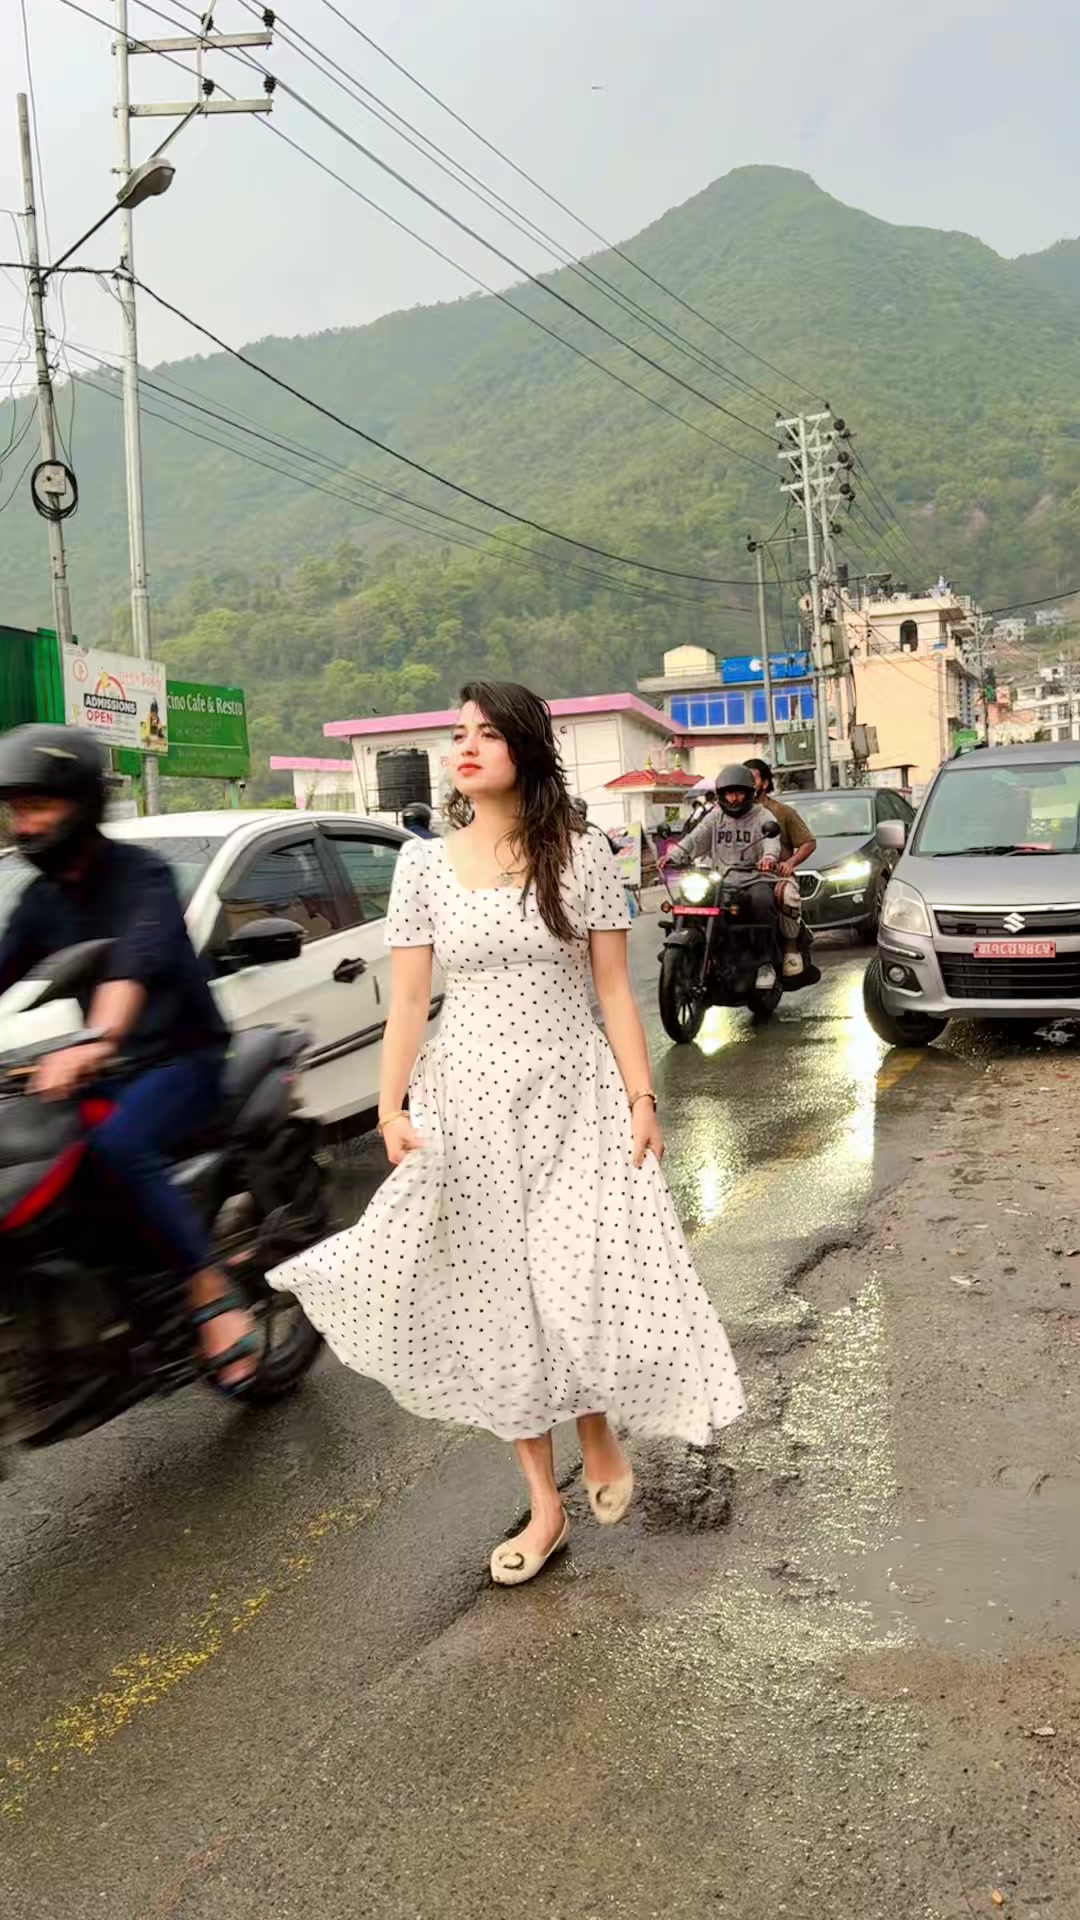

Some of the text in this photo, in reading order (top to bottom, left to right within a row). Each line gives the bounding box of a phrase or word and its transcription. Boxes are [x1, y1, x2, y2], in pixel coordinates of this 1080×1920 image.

[85, 695, 136, 714] ADMISSIONS
[187, 693, 207, 713] Cafe
[207, 696, 215, 713] &
[87, 710, 113, 724] OPEN
[717, 830, 751, 844] POLO
